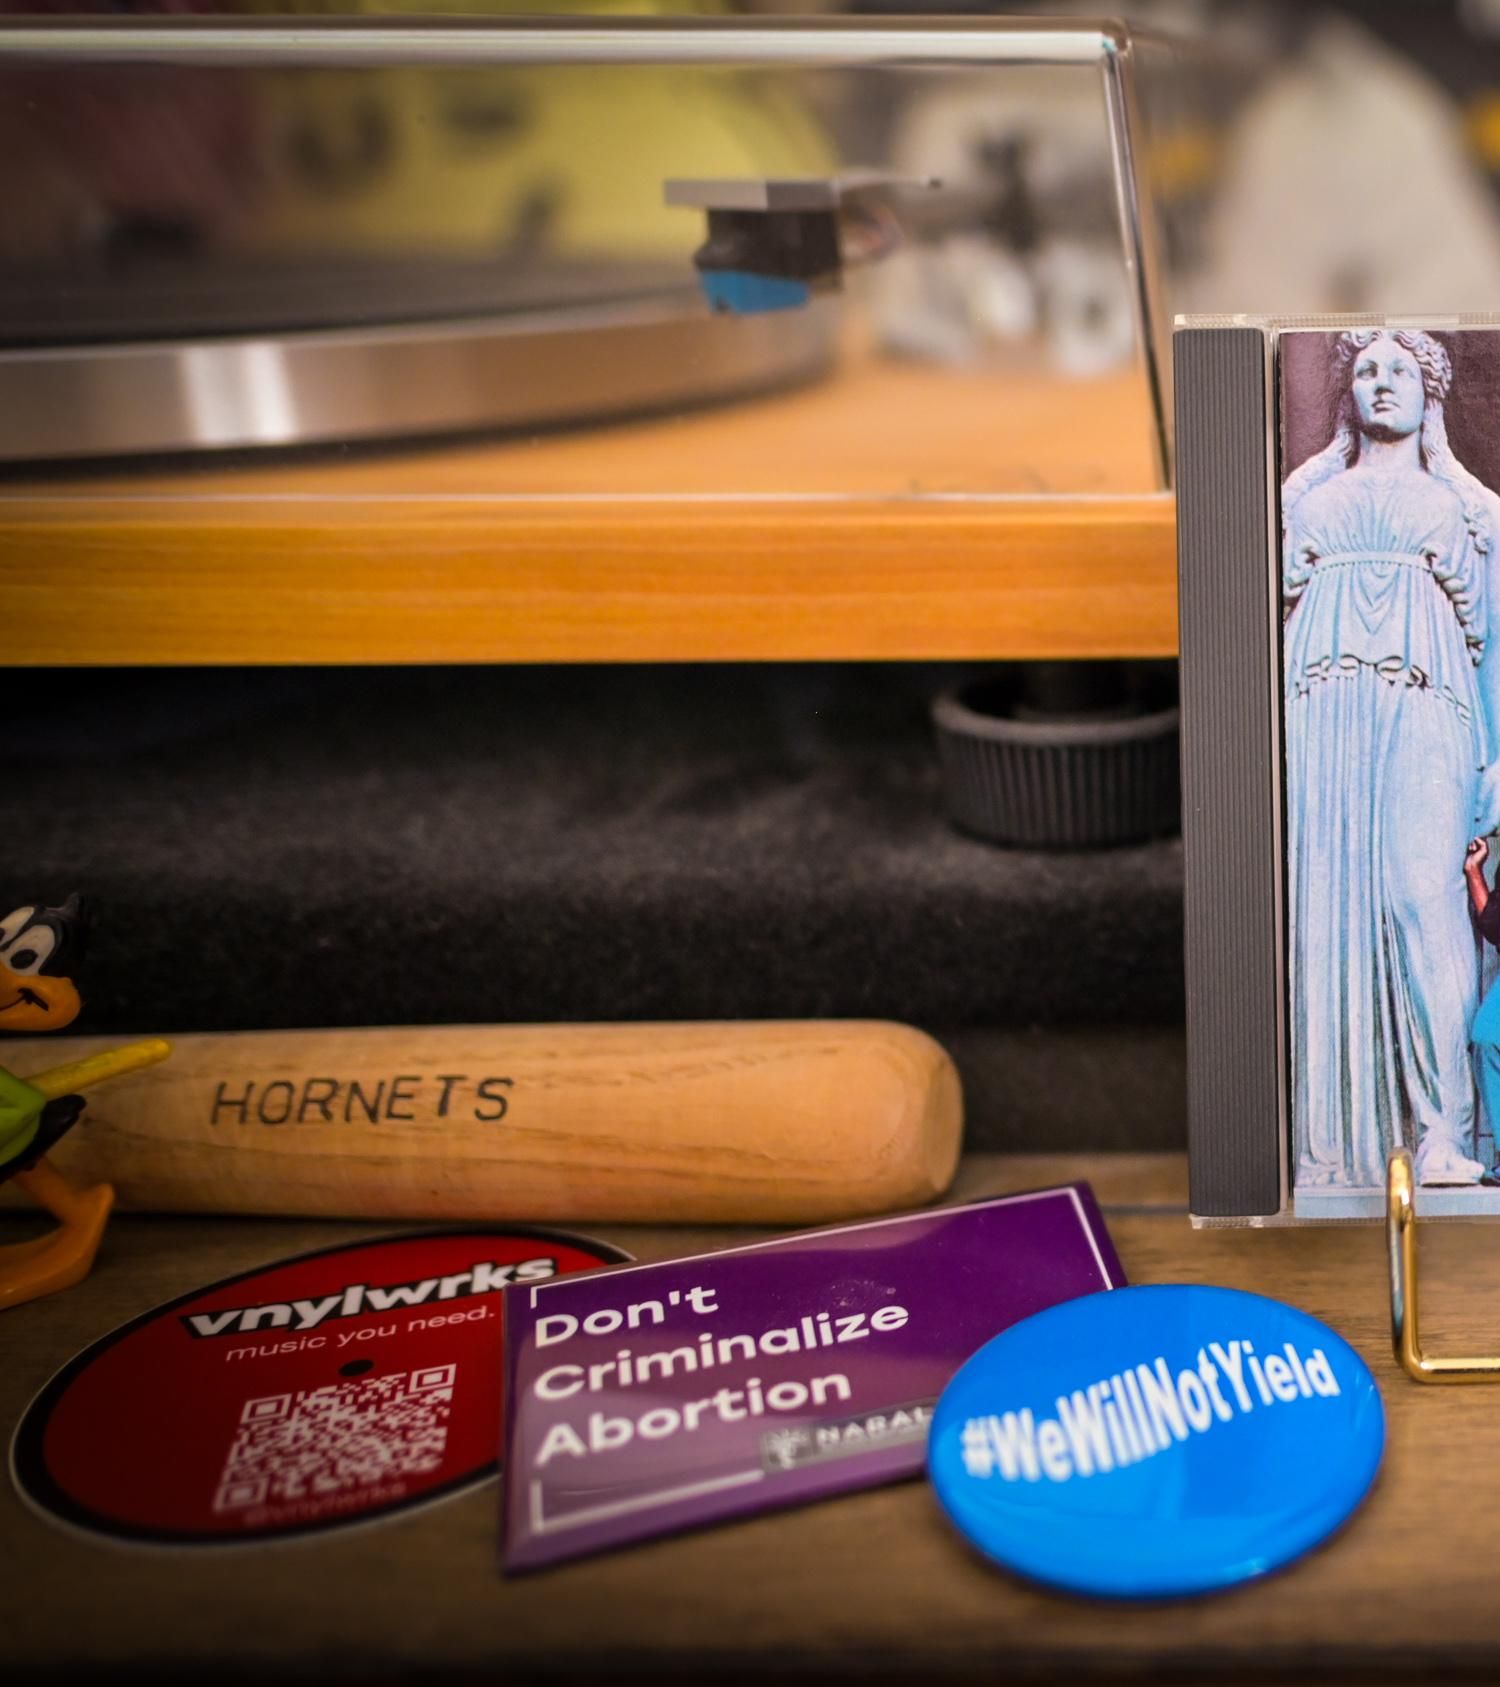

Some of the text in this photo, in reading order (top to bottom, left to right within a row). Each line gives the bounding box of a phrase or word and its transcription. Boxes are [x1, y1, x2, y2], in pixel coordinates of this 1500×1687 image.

[210, 1074, 514, 1125] HORNETS
[189, 1257, 554, 1336] vnylwrks
[226, 1305, 495, 1362] music you need.
[535, 1286, 719, 1349] Don't
[534, 1304, 909, 1400] Criminalize
[535, 1373, 851, 1466] Abortion
[960, 1339, 1341, 1482] #WeWillNotYield
